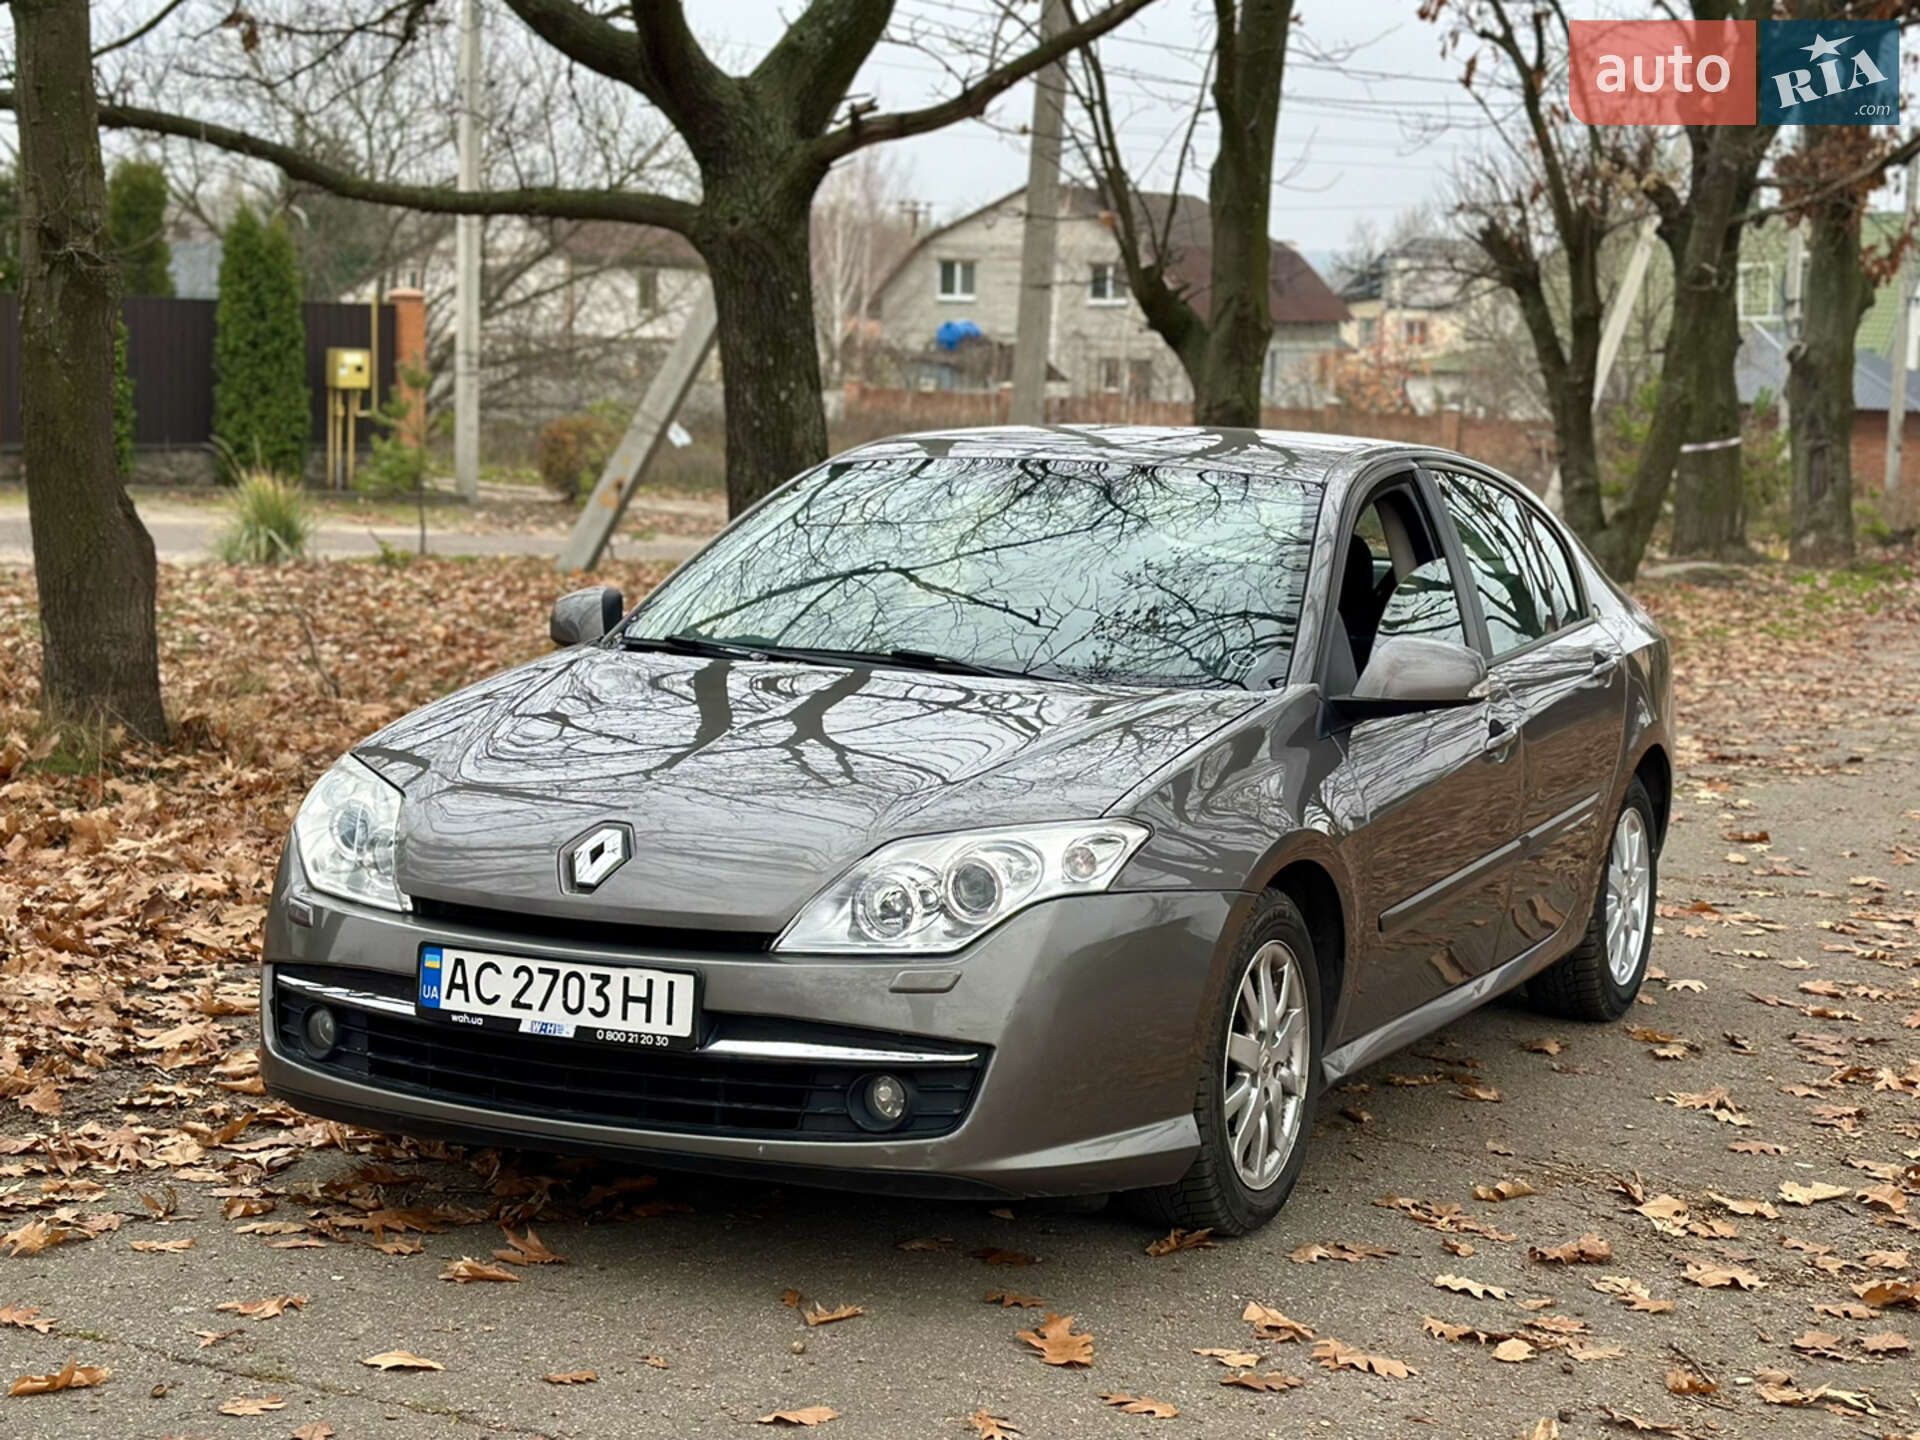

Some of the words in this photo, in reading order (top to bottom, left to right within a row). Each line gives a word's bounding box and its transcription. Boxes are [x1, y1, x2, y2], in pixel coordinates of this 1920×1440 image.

[422, 984, 439, 1000] UA
[596, 1029, 604, 1040] 0
[605, 1030, 626, 1043] 800
[627, 1032, 639, 1044] 21
[640, 1033, 653, 1046] 20
[655, 1035, 669, 1047] 30
